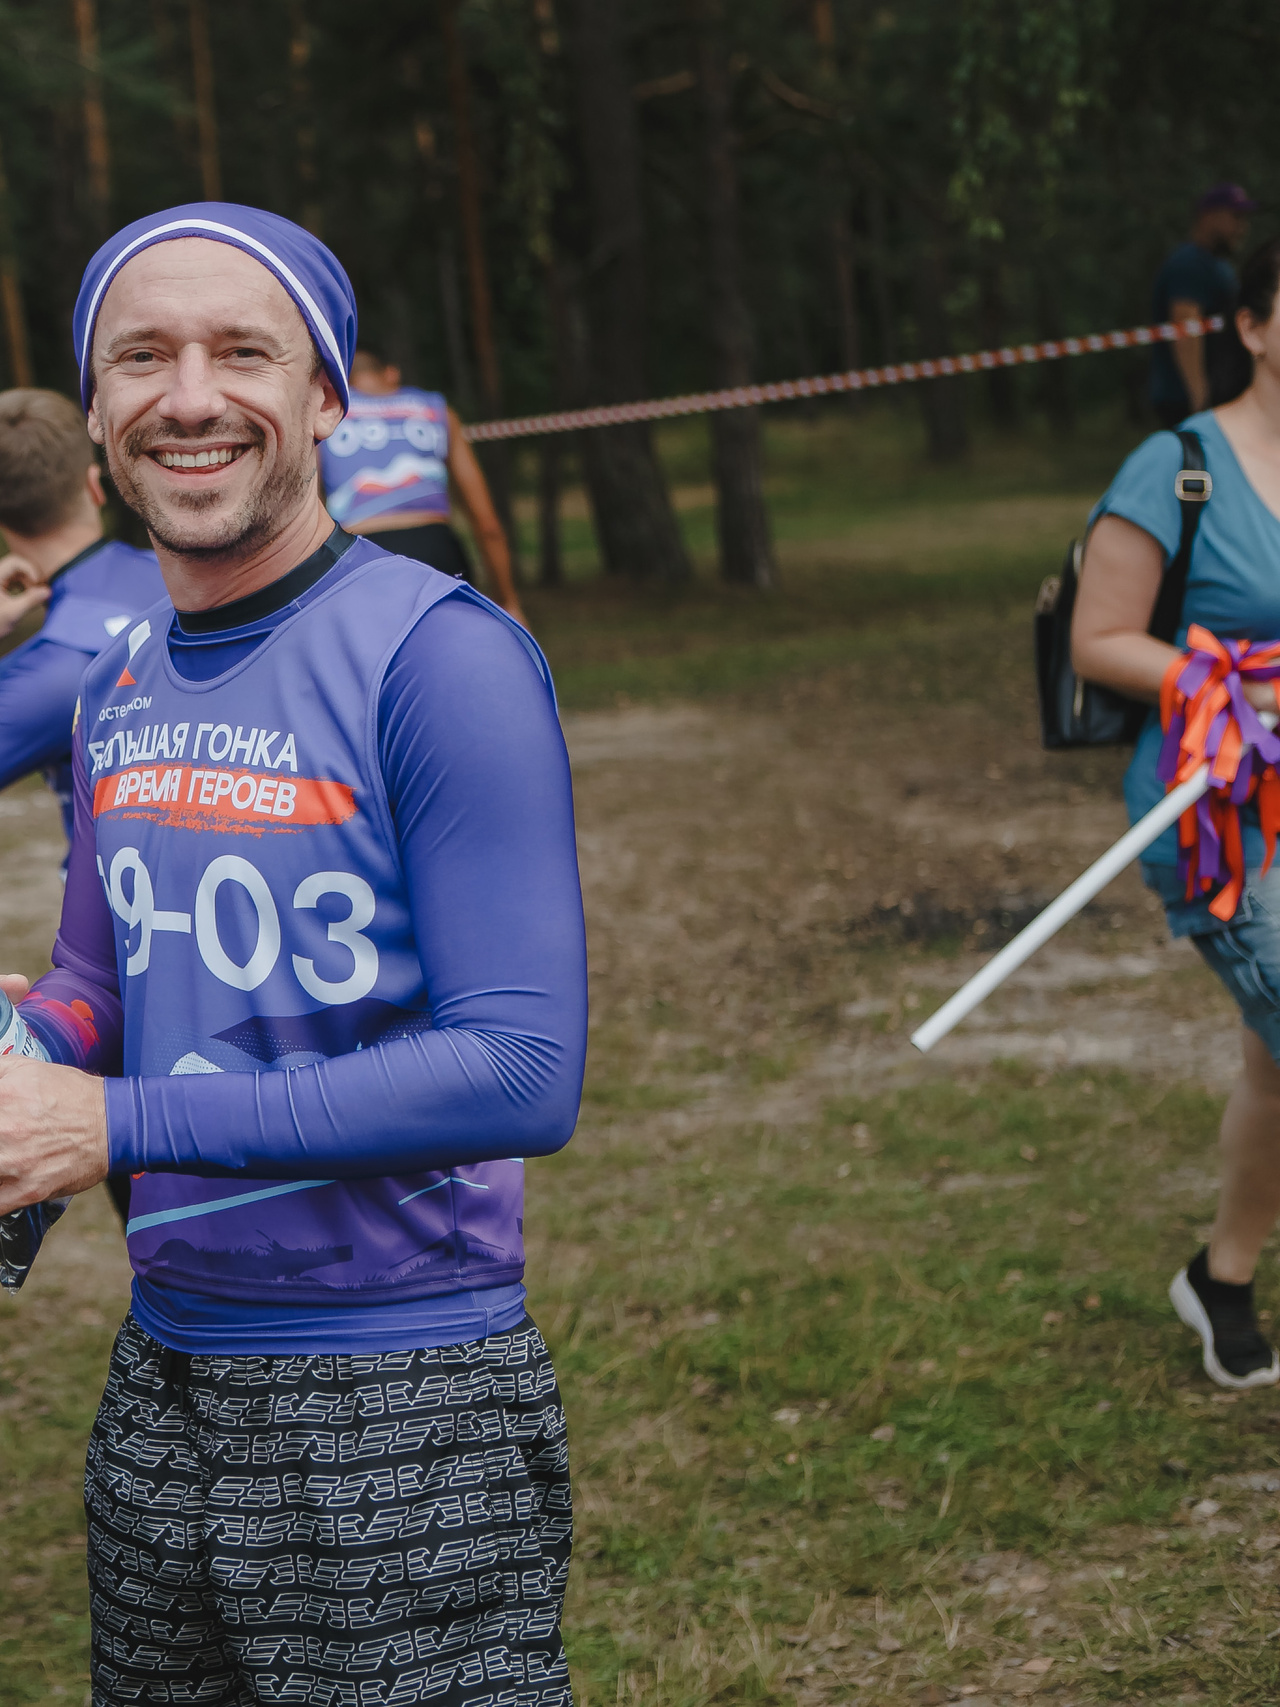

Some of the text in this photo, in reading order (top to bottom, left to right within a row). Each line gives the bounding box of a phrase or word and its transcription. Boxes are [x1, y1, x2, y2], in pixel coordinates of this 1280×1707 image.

[192, 722, 298, 772] ГОНКА
[114, 768, 297, 818] ВРЕМЯ ГЕРОЕВ
